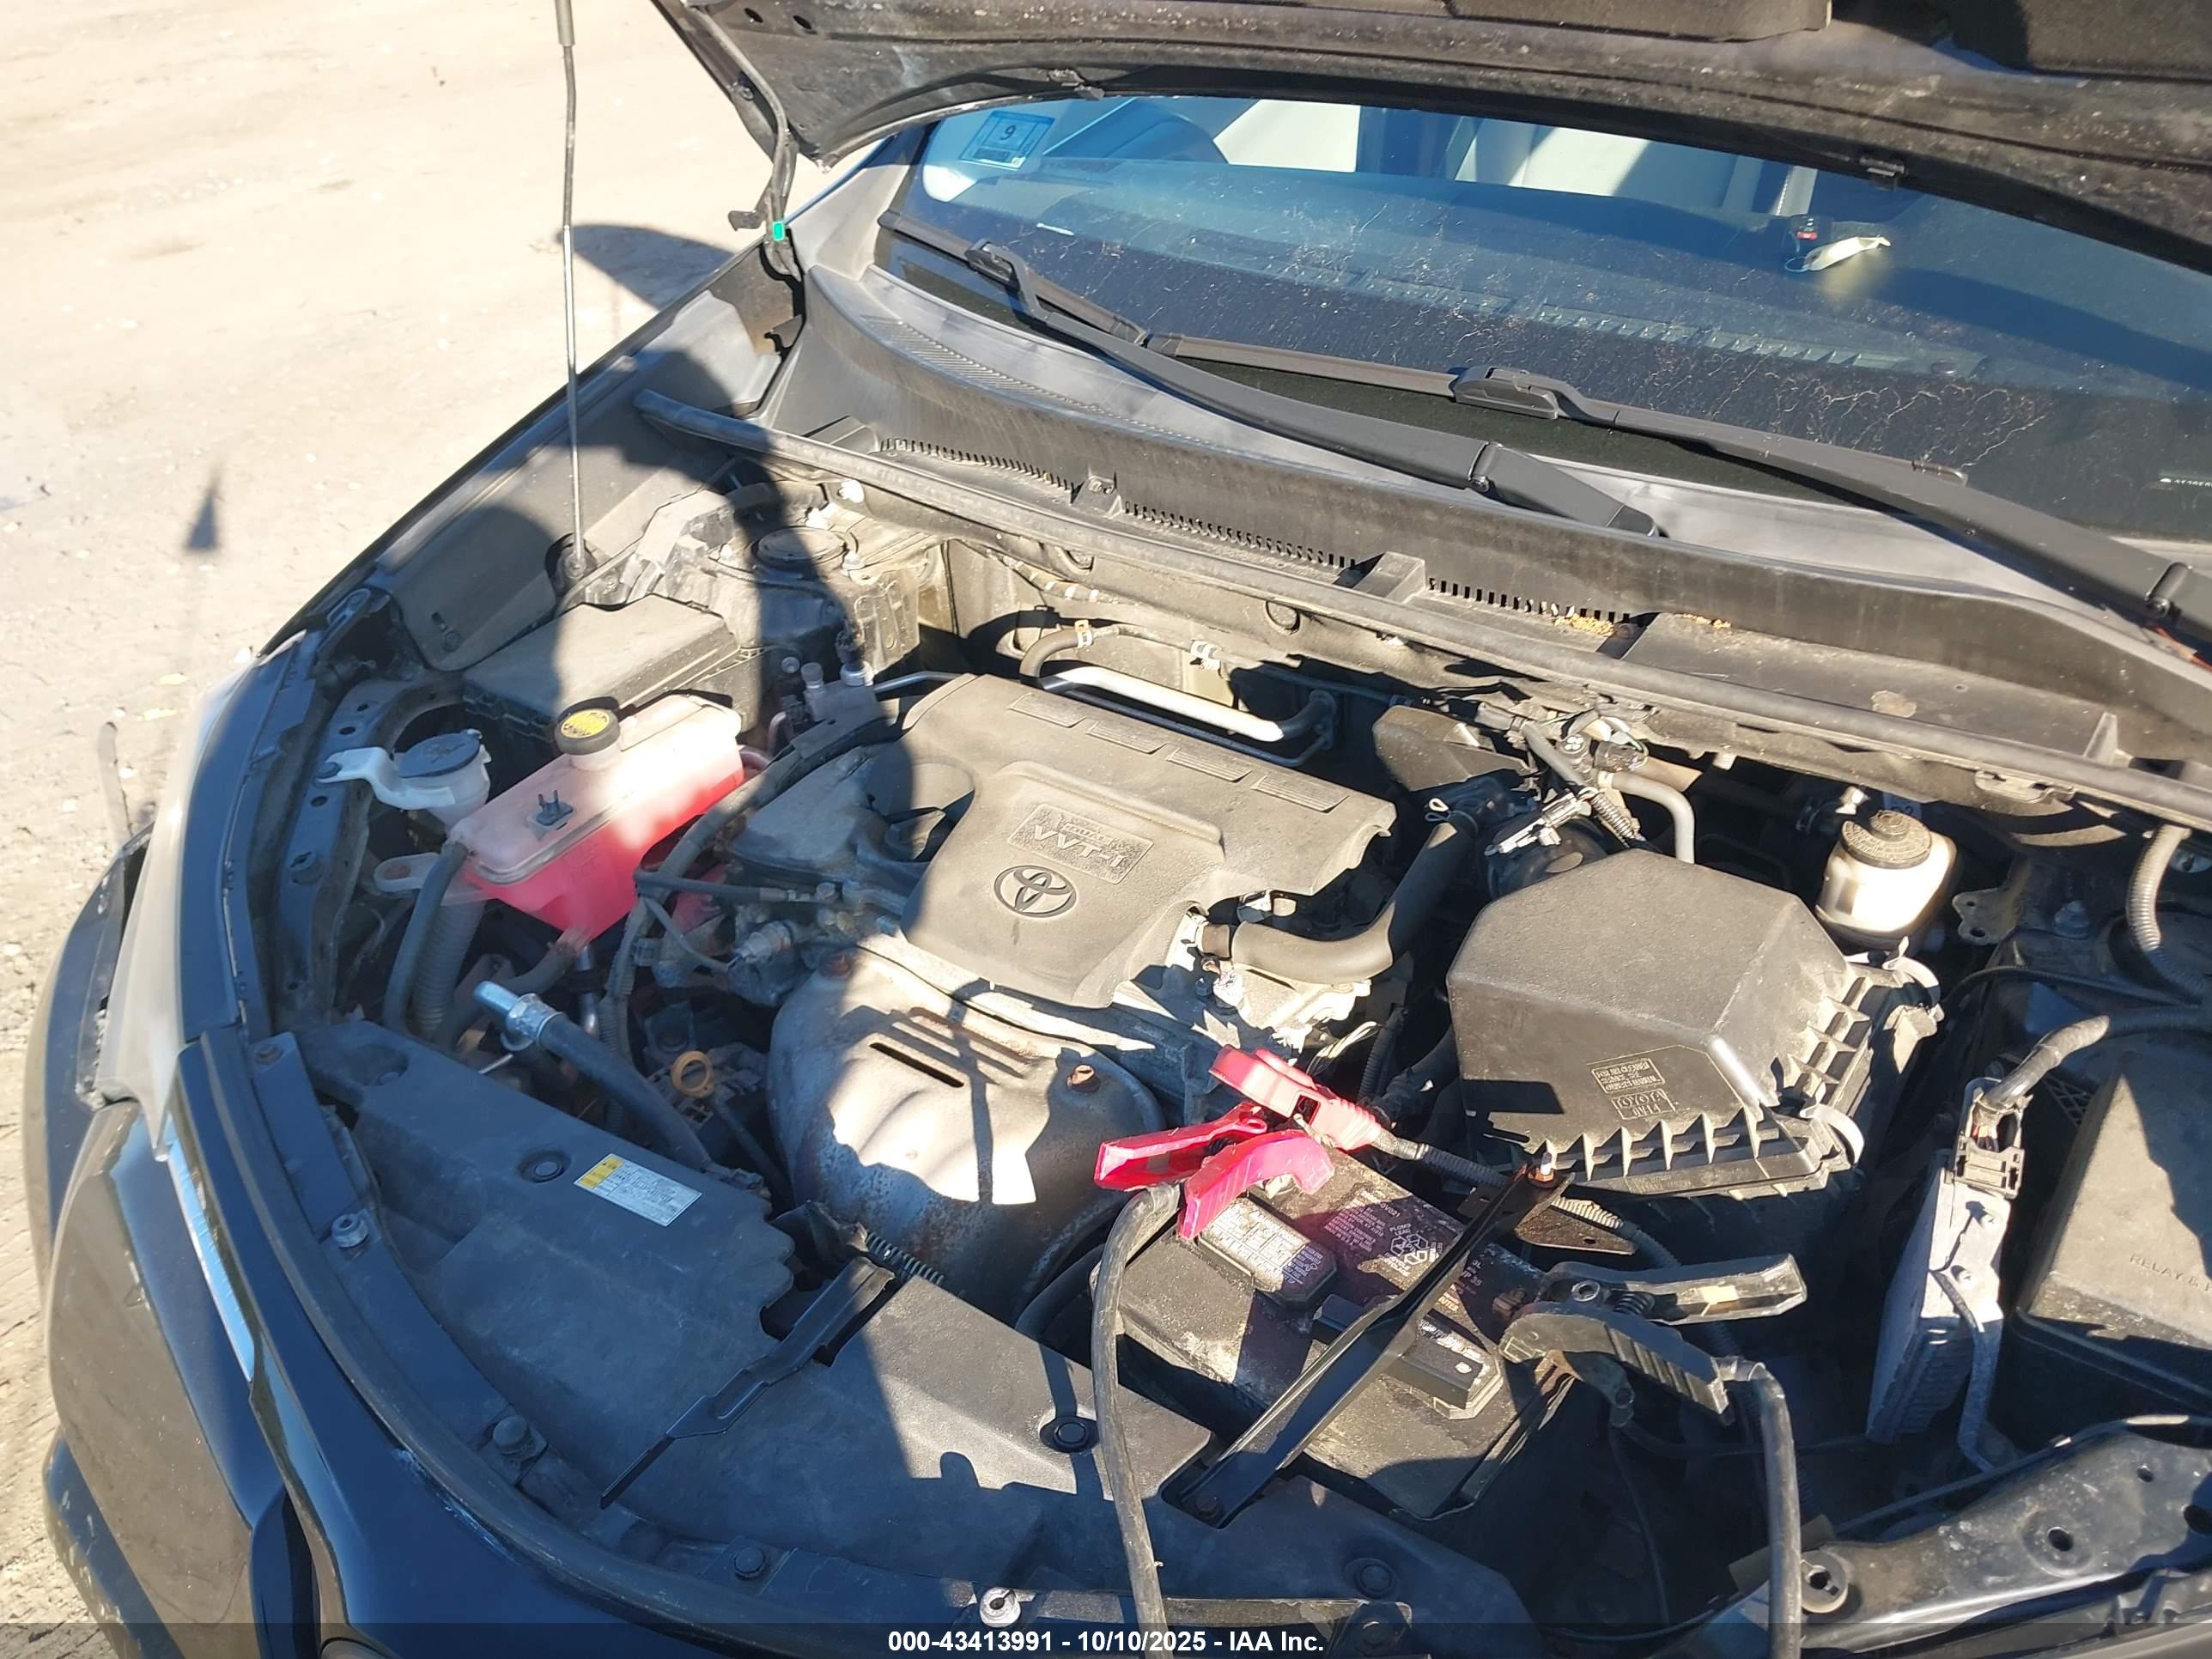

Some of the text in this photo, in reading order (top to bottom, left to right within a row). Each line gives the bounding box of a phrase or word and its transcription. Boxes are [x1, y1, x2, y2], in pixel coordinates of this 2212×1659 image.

[1000, 124, 1017, 141] 9
[1616, 1091, 1667, 1109] TOYOTA
[2130, 1254, 2184, 1280] RELAY
[2188, 1276, 2199, 1287] &
